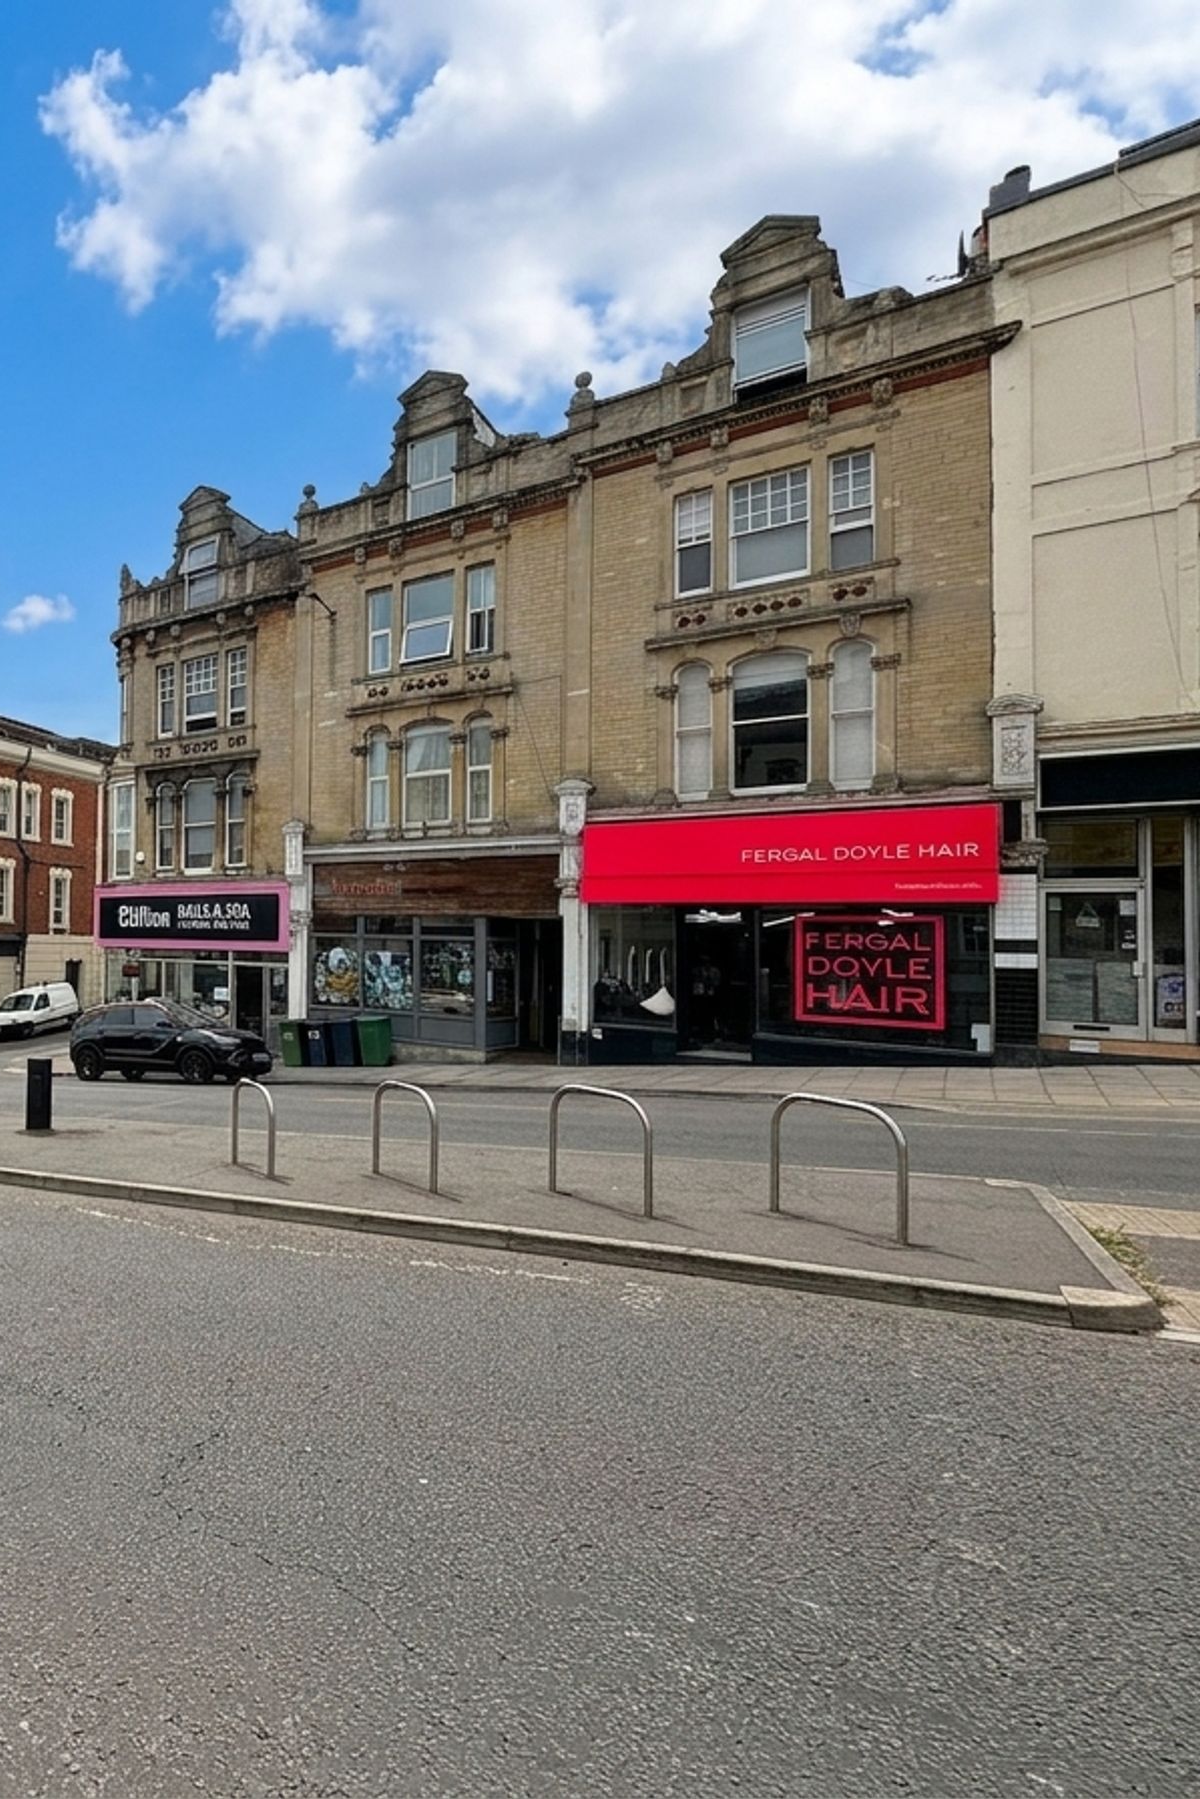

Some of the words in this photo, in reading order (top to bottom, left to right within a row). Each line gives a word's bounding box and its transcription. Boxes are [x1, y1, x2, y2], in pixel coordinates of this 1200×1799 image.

[741, 847, 827, 863] FERGAL
[833, 844, 910, 861] DOYLE
[918, 842, 980, 858] HAIR
[806, 932, 931, 951] FERGAL
[808, 956, 932, 979] DOYLE
[806, 983, 930, 1015] HAIR
